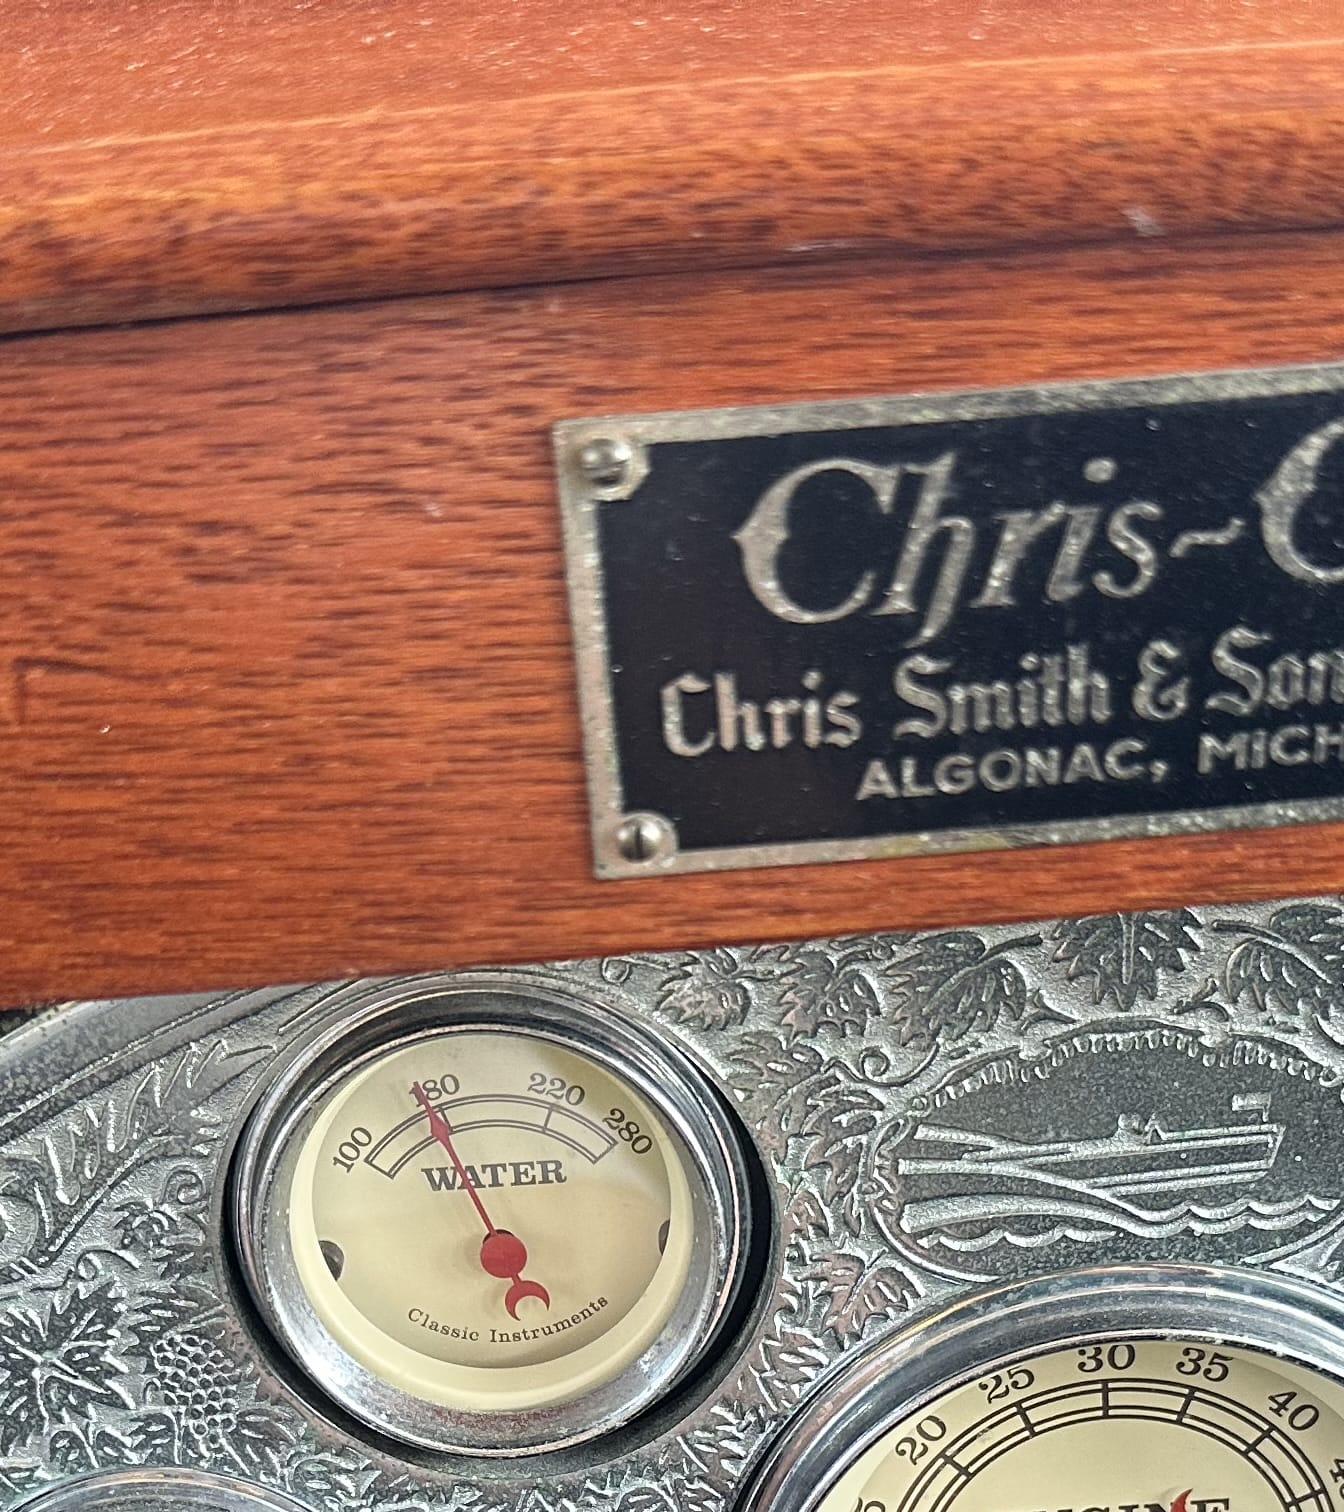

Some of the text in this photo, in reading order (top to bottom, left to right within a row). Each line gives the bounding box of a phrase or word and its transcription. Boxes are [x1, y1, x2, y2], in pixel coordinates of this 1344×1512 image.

[661, 672, 861, 757] Chris
[893, 643, 1113, 740] Smith
[1132, 640, 1188, 722] &
[857, 738, 1169, 800] ALGONAC,
[332, 1126, 373, 1173] 100
[526, 1072, 585, 1107] 220
[602, 1108, 653, 1156] 280
[421, 1159, 567, 1192] WATER
[408, 1295, 609, 1343] Classic Instruments
[894, 1413, 948, 1465] 20
[978, 1366, 1036, 1404] 25
[1076, 1343, 1137, 1373] 30
[1174, 1346, 1234, 1382] 35
[1266, 1387, 1320, 1433] 40
